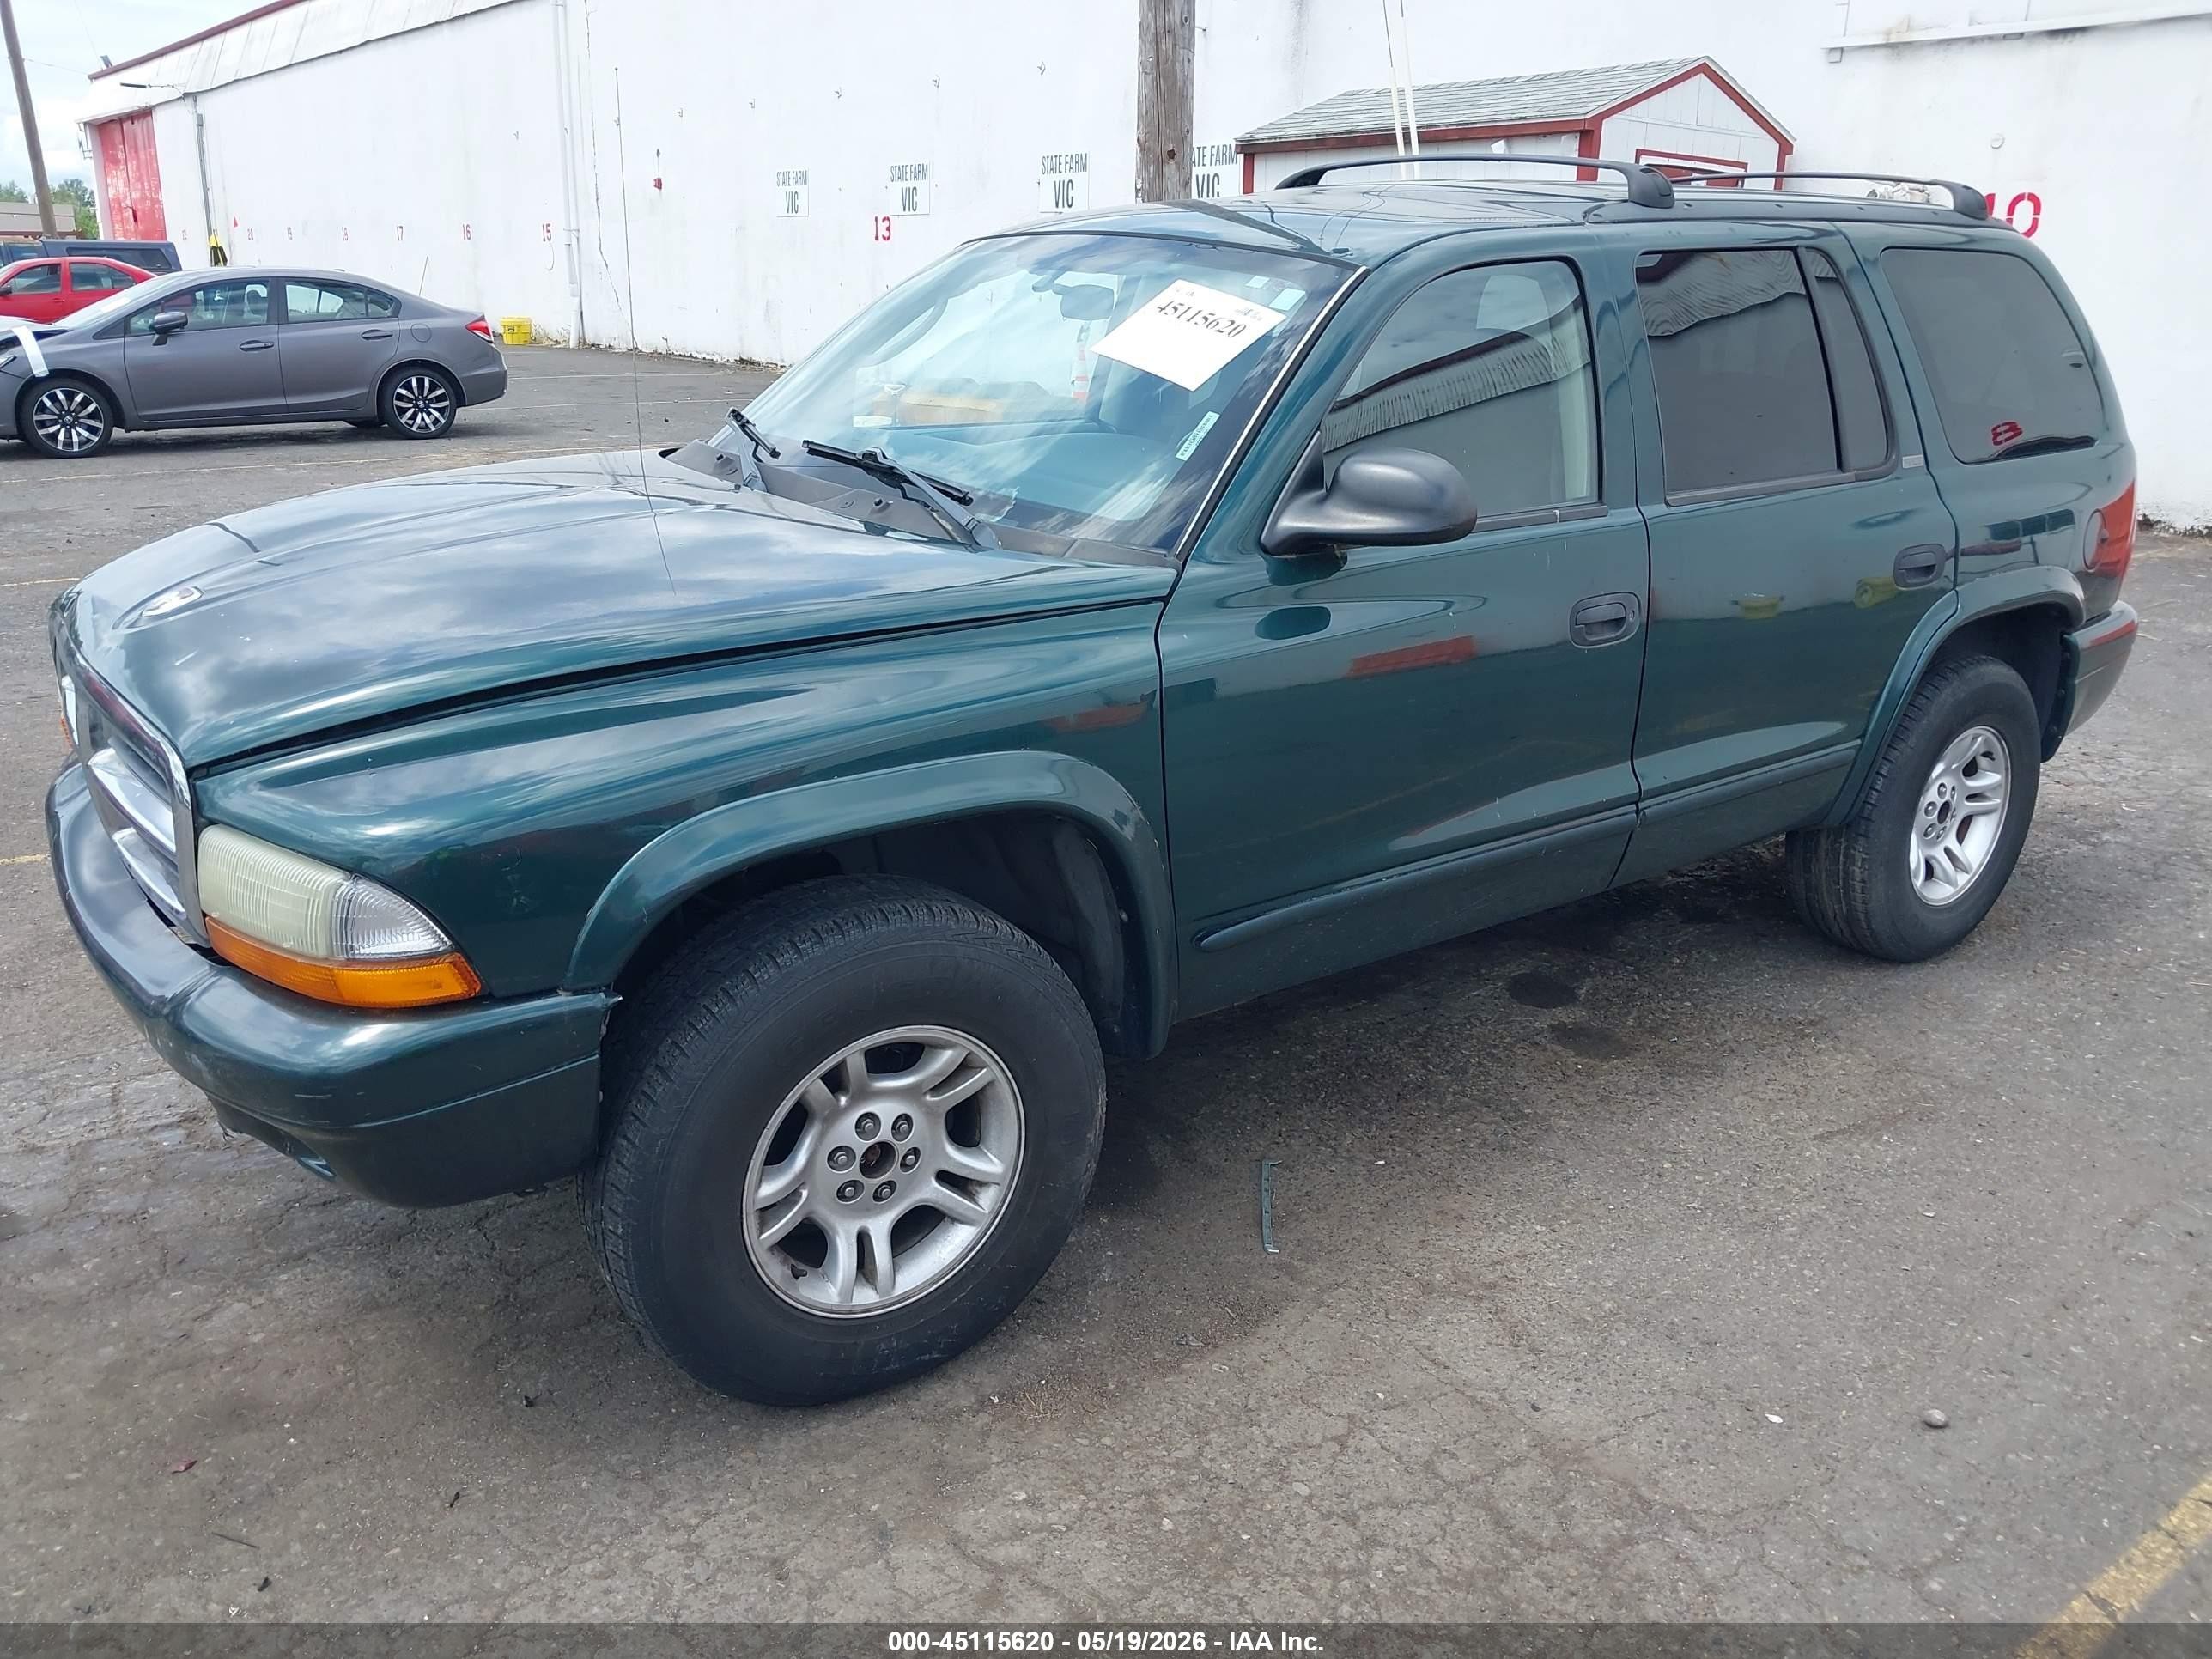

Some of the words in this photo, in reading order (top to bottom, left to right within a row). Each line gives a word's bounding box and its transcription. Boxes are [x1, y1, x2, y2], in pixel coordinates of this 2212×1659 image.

[1041, 155, 1062, 175] STATE
[1065, 153, 1087, 173] FARM
[1192, 146, 1207, 167] ATE
[1210, 144, 1237, 167] FARM
[776, 171, 791, 187] STATE
[792, 170, 807, 186] FARM
[890, 165, 908, 183] STATE
[910, 163, 928, 181] FARM
[1054, 179, 1074, 209] VIC
[1195, 173, 1220, 198] VIC
[786, 191, 799, 214] VIC
[901, 186, 918, 212] VIC
[396, 225, 404, 241] 17
[462, 223, 471, 240] 16
[542, 223, 552, 242] 15
[874, 216, 891, 241] 13
[1157, 301, 1247, 337] 45115620
